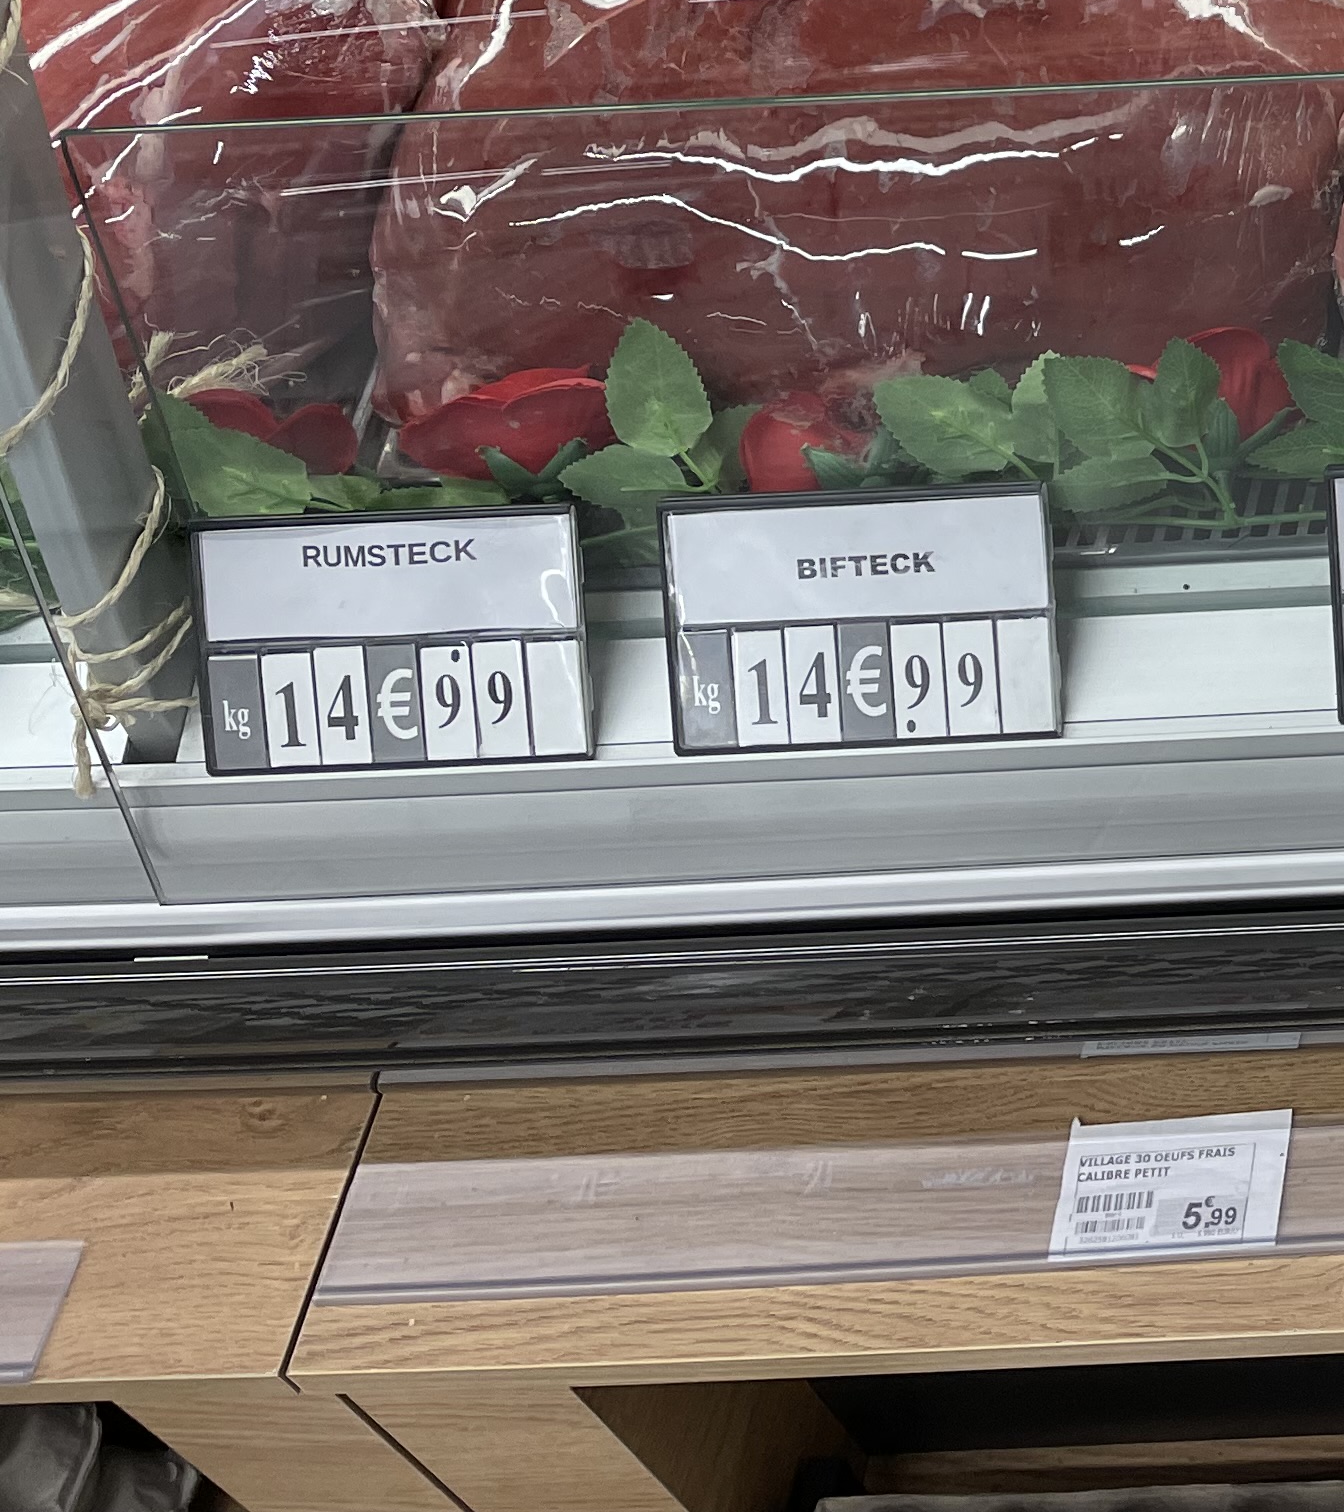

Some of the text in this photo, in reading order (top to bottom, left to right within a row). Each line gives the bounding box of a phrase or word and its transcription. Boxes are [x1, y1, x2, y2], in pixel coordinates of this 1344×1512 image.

[302, 538, 477, 569] RUMSTECK
[796, 550, 936, 580] BIFTECK
[693, 675, 720, 715] kg
[223, 699, 252, 740] kg
[1080, 1147, 1236, 1168] VILLAGE 30 OEUFS FRAIS
[1077, 1166, 1172, 1183] CALIBRE PETIT
